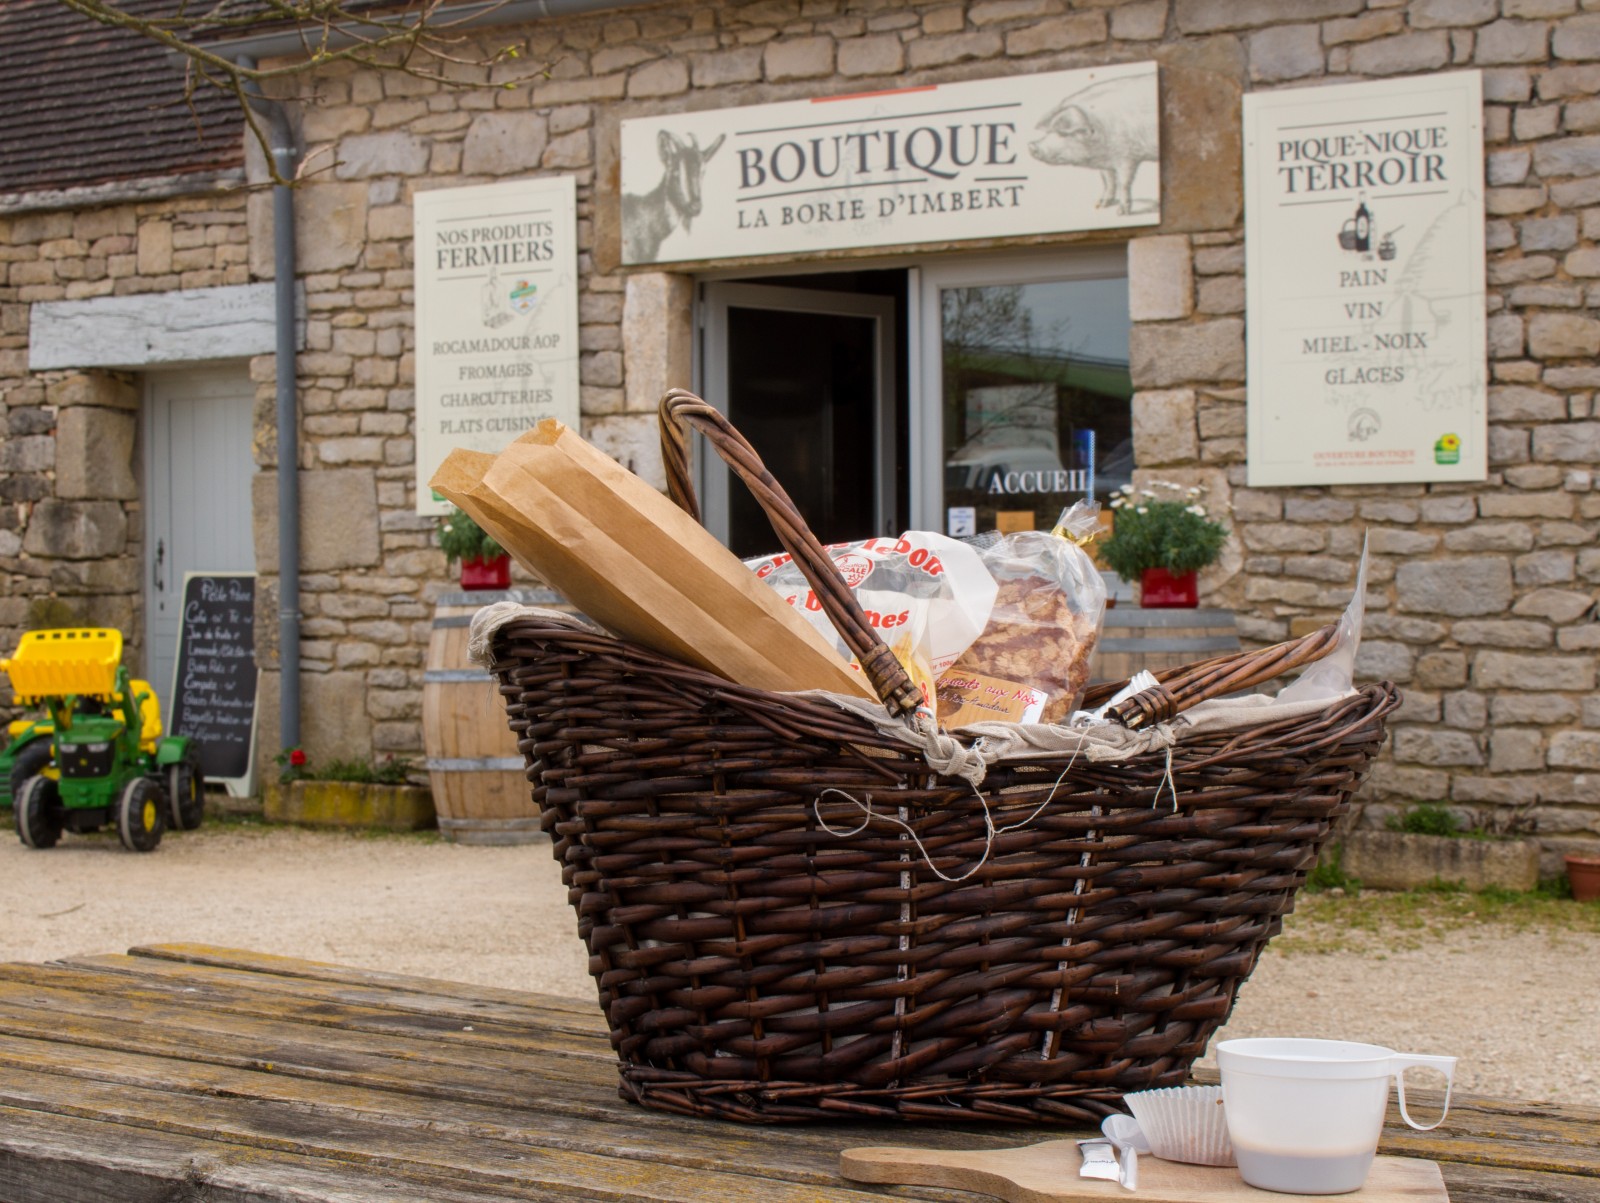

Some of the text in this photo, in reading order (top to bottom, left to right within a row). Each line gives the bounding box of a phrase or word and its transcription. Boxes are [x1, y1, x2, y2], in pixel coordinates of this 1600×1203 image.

[737, 122, 1017, 189] BOUTIQUE
[1278, 126, 1449, 165] PIQUE-NIQUE
[1278, 154, 1449, 195] TERROIR
[738, 186, 1026, 230] LA BORIE D'IMBERT
[436, 221, 553, 247] NOS PRODUITS
[436, 239, 554, 270] FERMIERS
[1339, 268, 1388, 288] PAIN
[1344, 301, 1383, 320] VIN
[433, 334, 561, 356] ROCAMADOUR AOP
[1302, 334, 1359, 355] MIEL
[1374, 331, 1428, 353] NOIX
[458, 363, 534, 381] FROMAGES
[1325, 366, 1405, 386] GLACES
[440, 388, 554, 408] CHARCUTERIES
[439, 417, 483, 435] PLATS
[988, 469, 1088, 494] ACCUEIL
[985, 685, 1009, 702] aux
[1011, 689, 1039, 710] Noix
